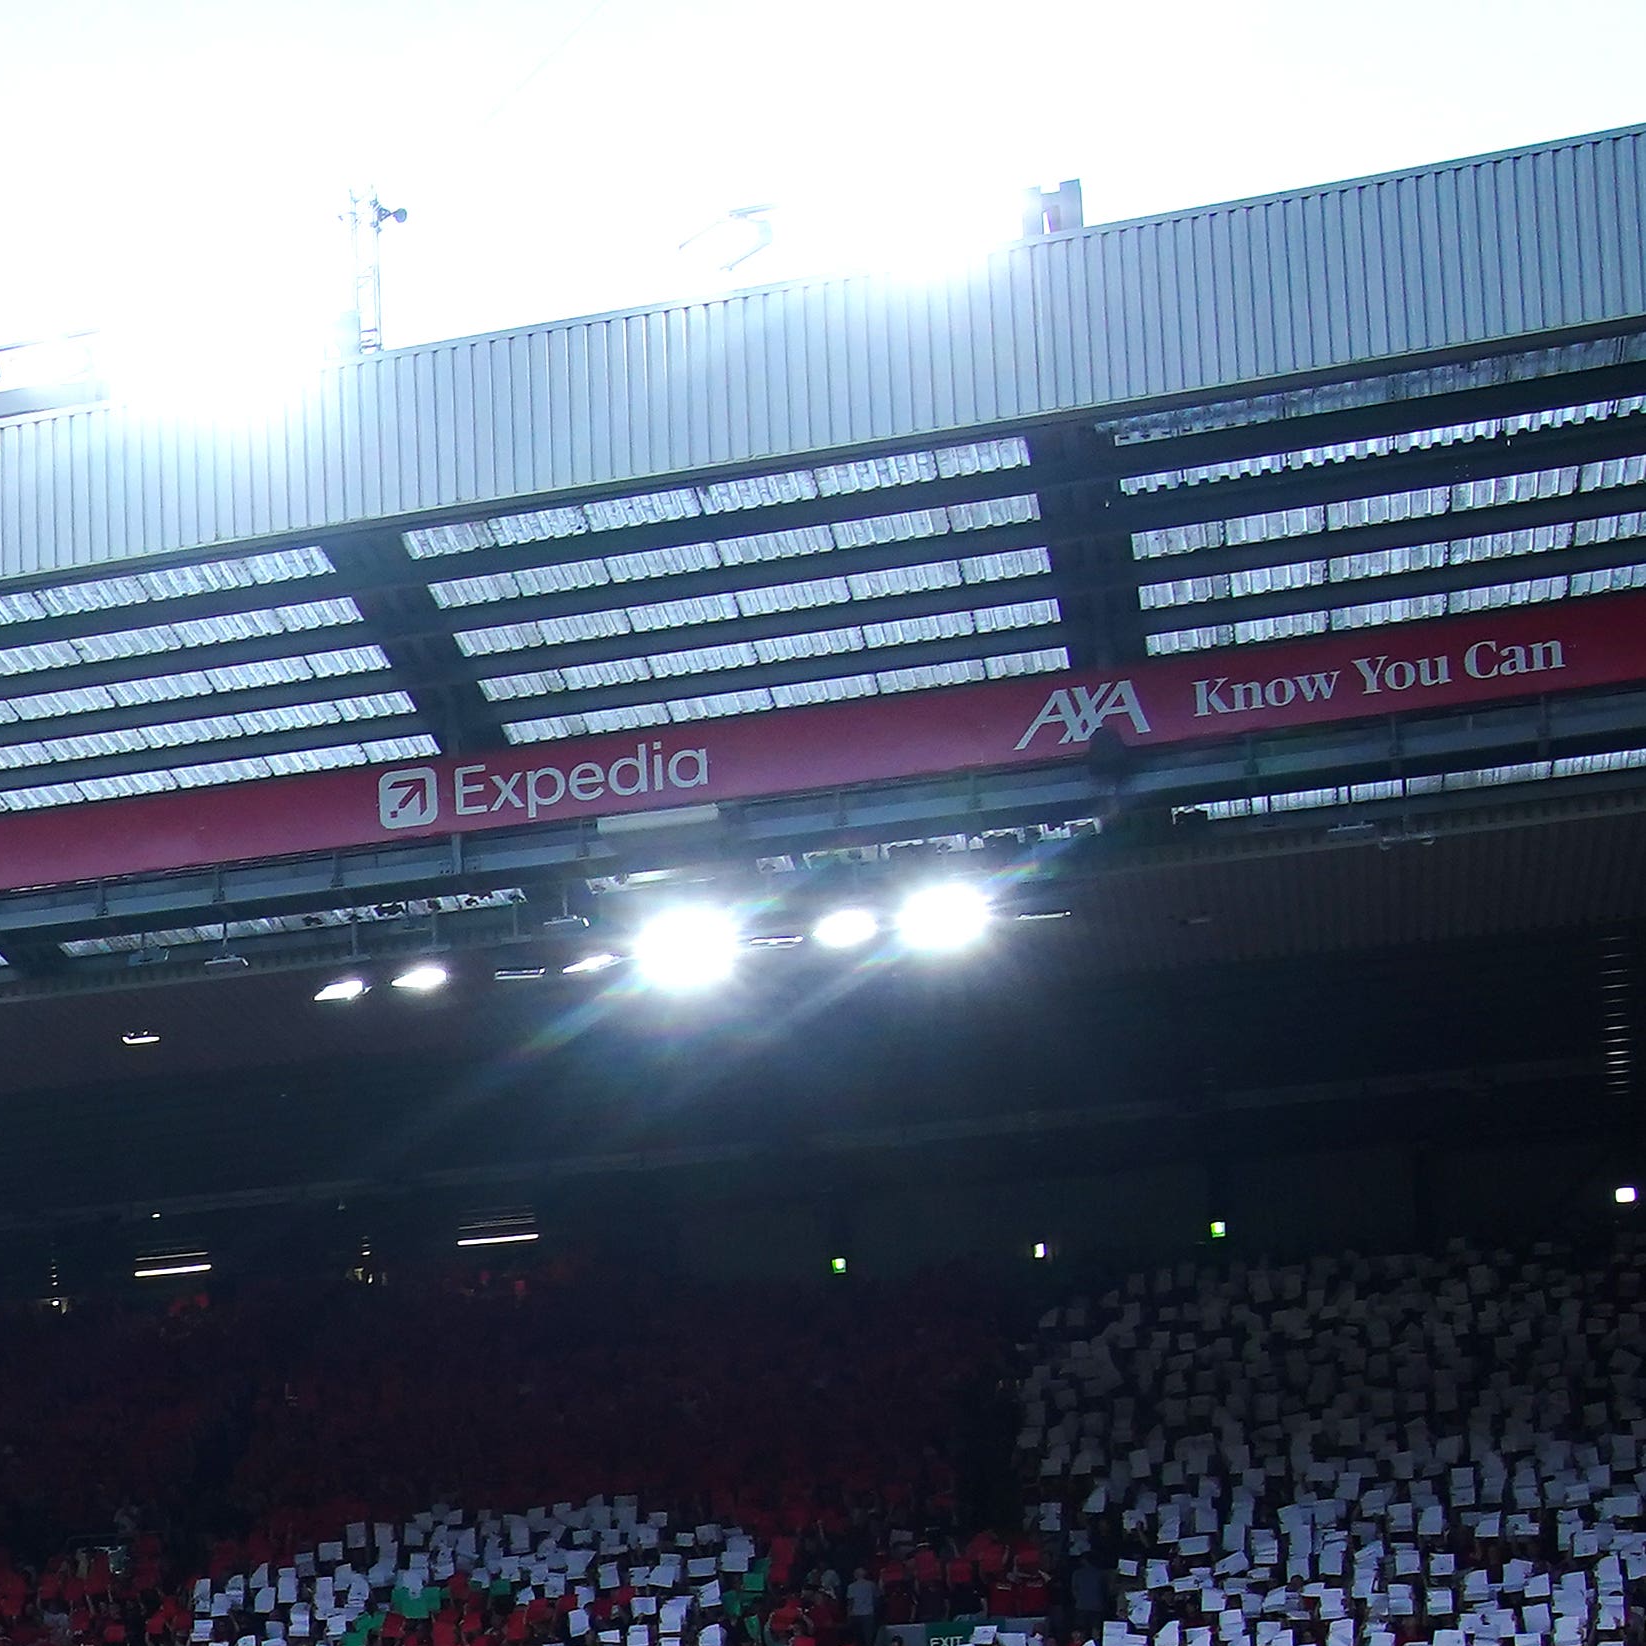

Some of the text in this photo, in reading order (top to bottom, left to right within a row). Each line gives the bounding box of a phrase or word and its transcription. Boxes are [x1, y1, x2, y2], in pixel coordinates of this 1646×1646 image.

[1014, 639, 1565, 751] AXA Know You Can
[454, 741, 709, 818] Expedia
